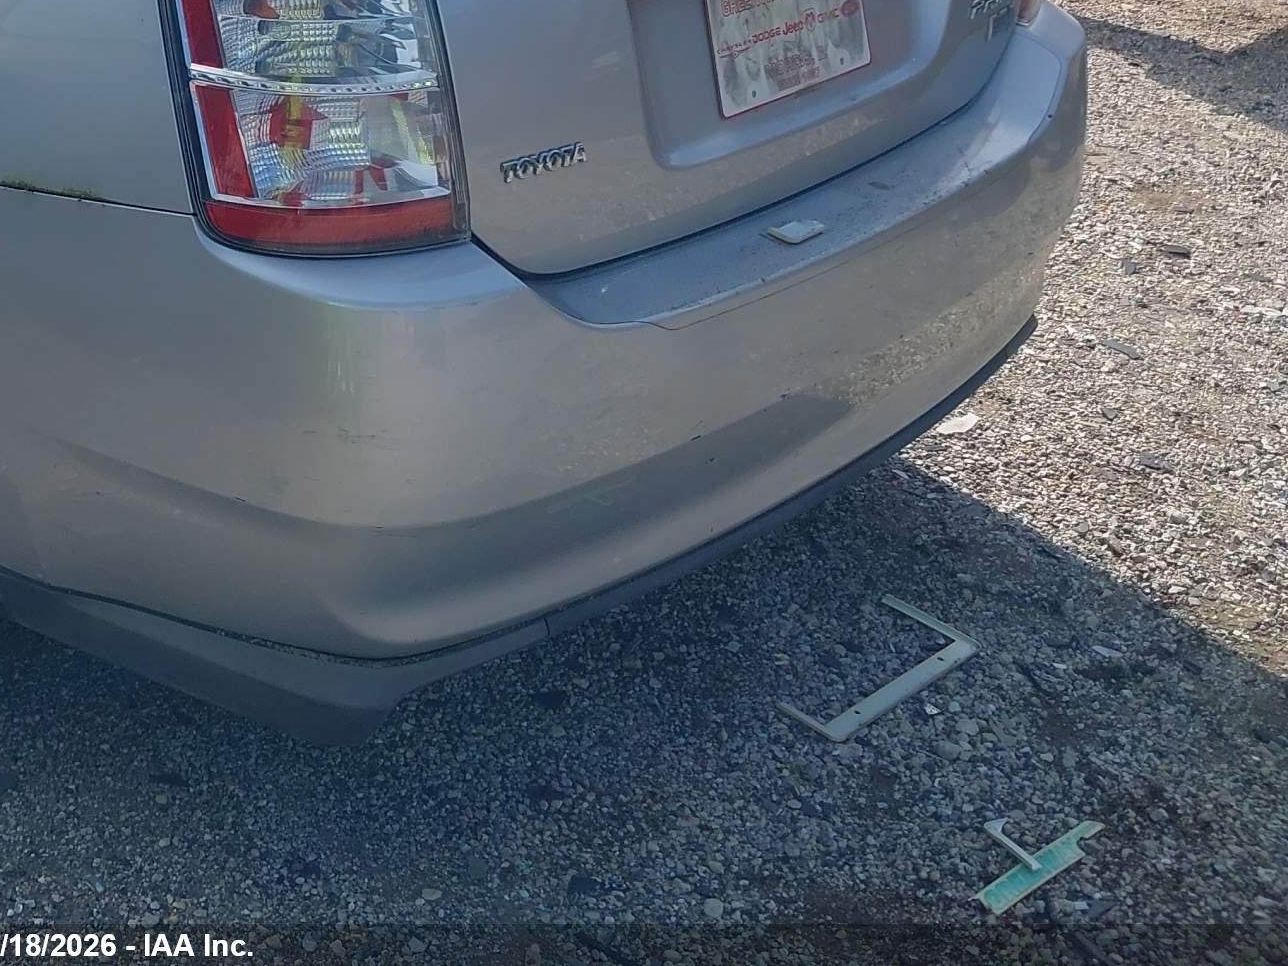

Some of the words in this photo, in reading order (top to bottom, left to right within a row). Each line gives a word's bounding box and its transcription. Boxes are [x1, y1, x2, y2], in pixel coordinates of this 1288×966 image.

[752, 27, 782, 44] DODGE
[782, 20, 804, 36] Jeep
[816, 7, 841, 24] GMC
[499, 141, 587, 184] TOYOTA
